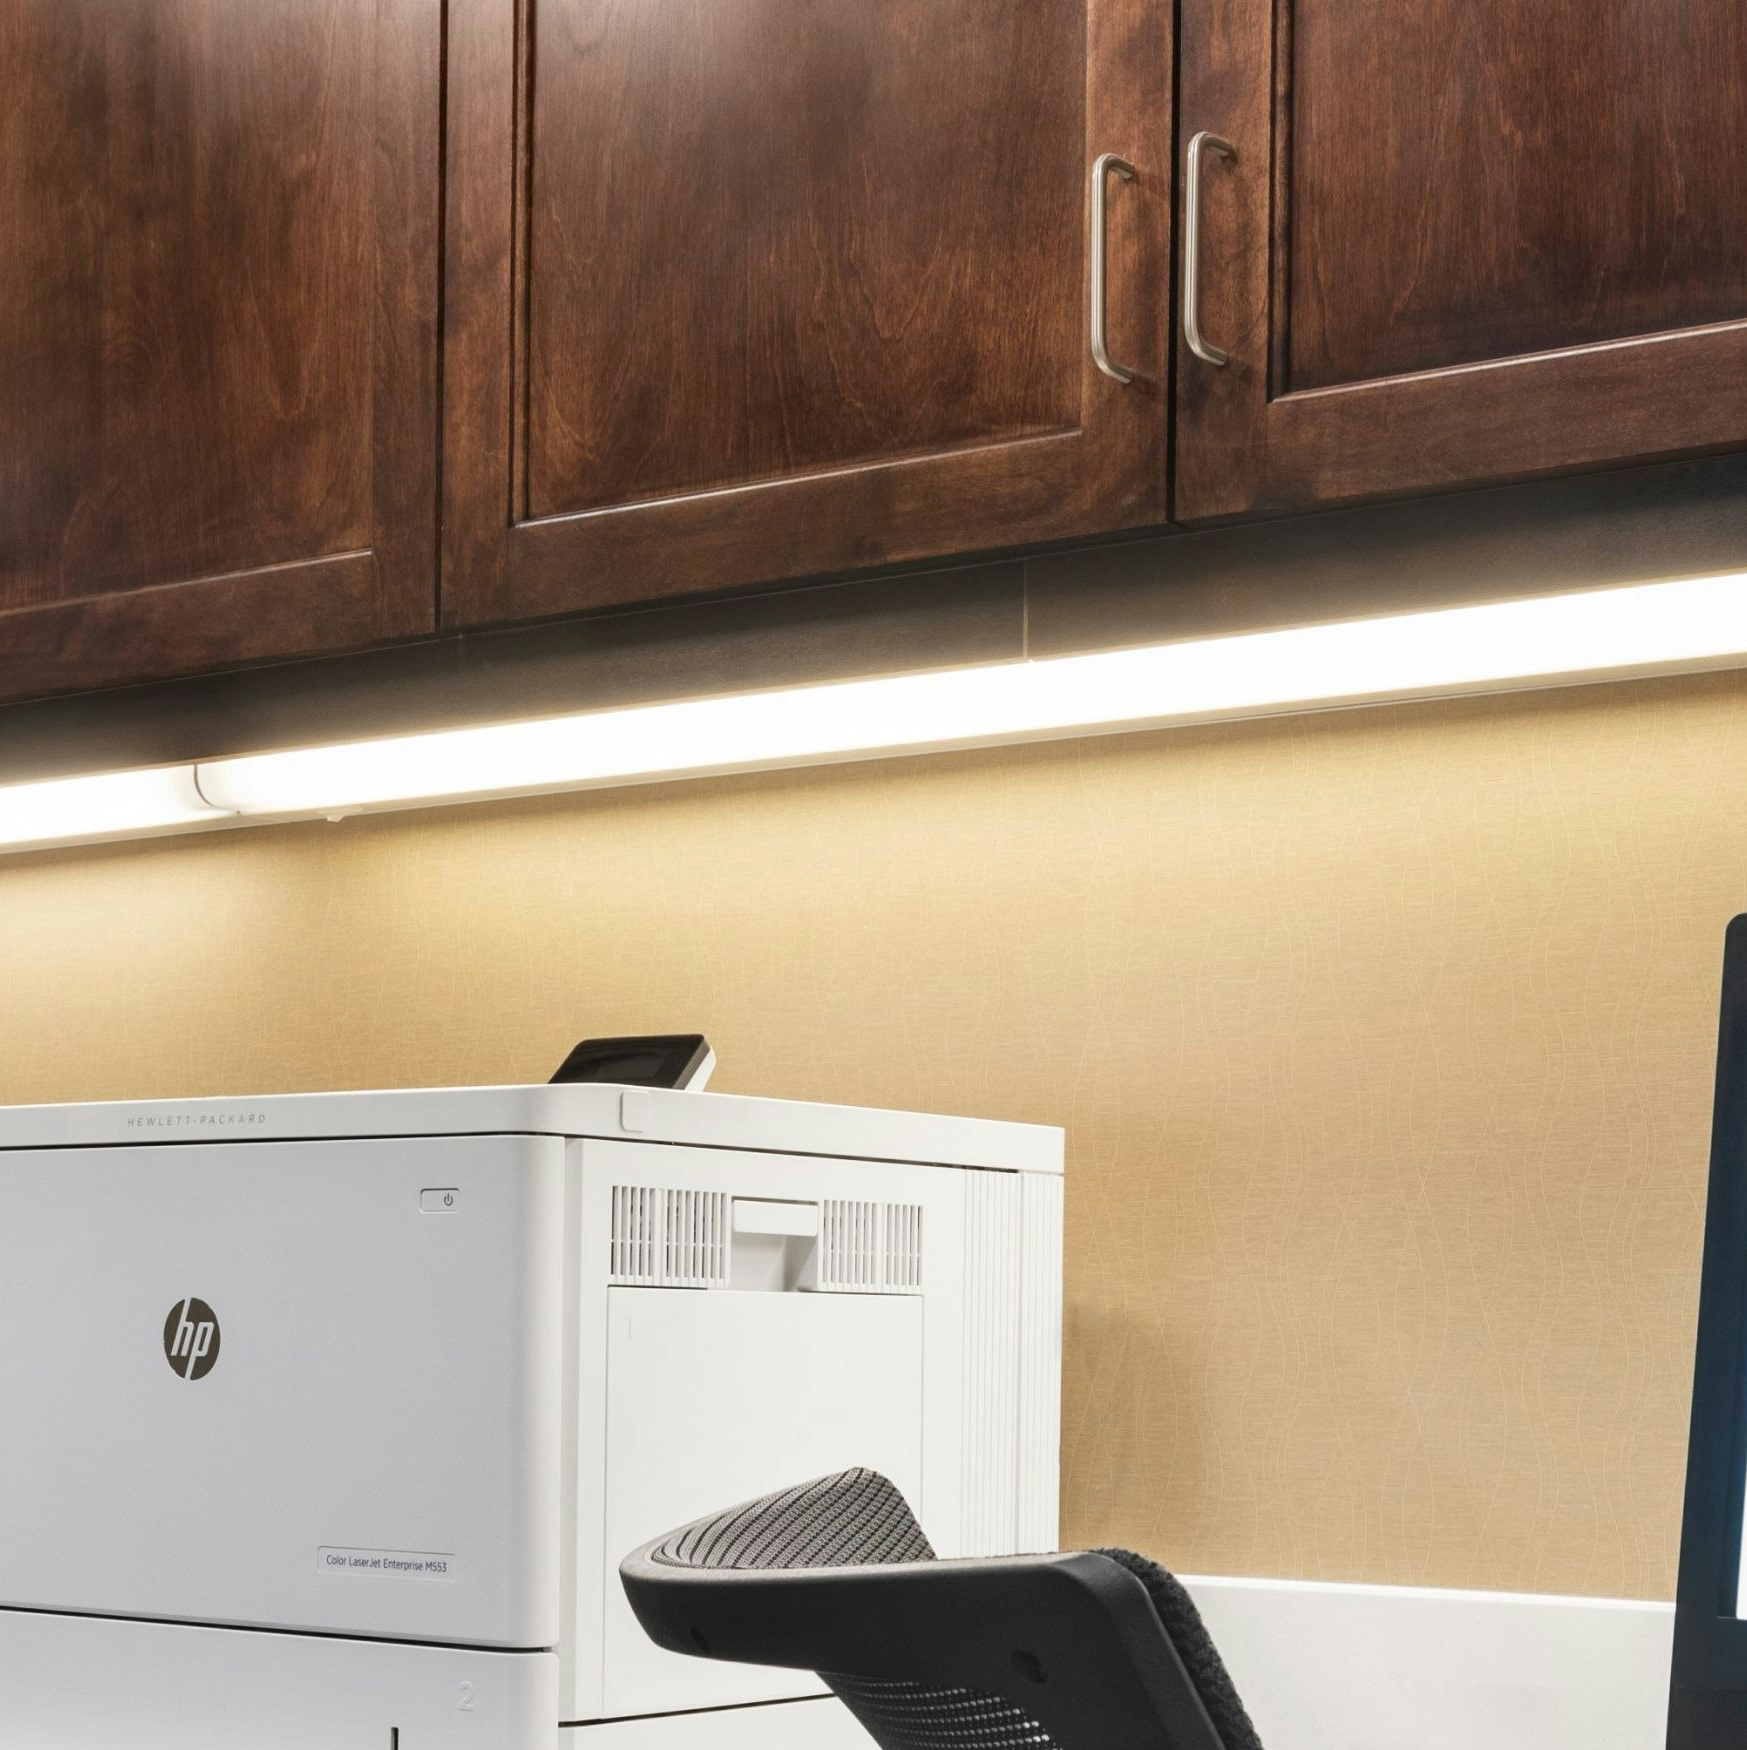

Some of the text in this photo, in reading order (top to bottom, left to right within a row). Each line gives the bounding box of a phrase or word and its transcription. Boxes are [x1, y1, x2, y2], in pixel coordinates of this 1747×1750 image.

[128, 1114, 266, 1128] HEWLETT-PACKARD
[167, 1297, 217, 1380] hp
[326, 1555, 447, 1572] Color LaserJet Enterprise M553
[458, 1681, 475, 1712] 2
